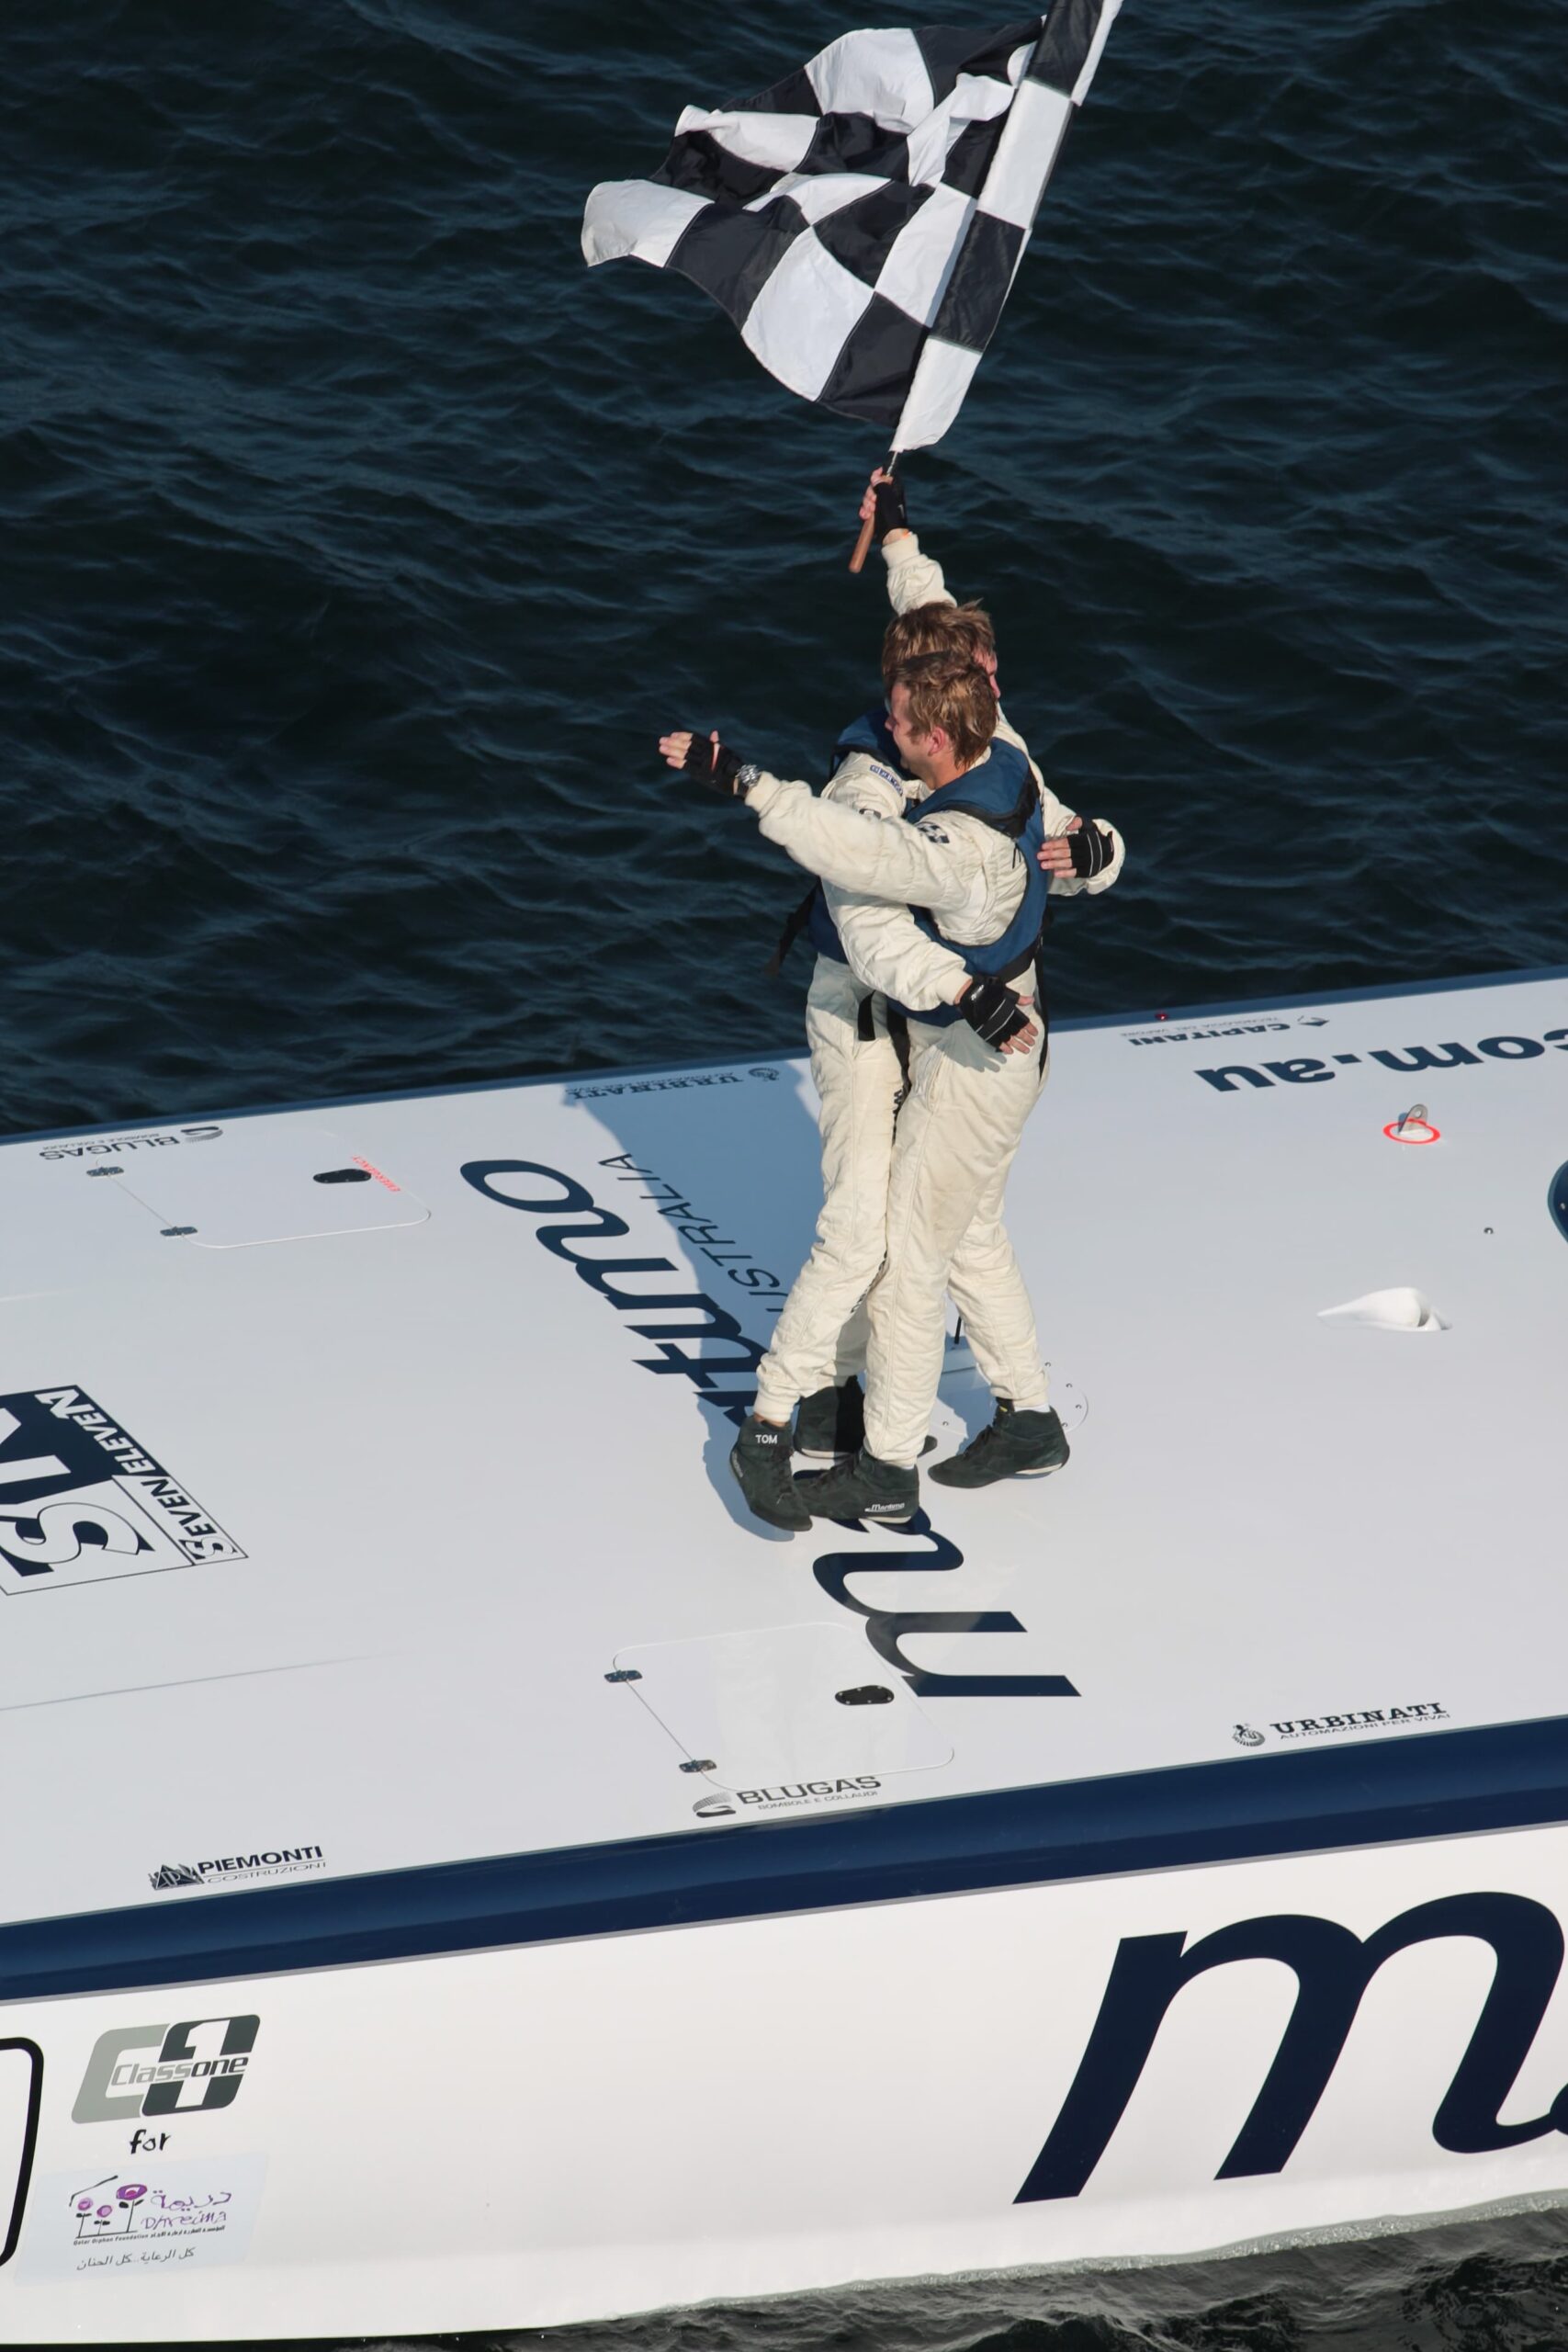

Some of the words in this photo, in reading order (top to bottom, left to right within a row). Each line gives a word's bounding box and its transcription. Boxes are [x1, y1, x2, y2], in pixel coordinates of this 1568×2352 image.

[1128, 1023, 1291, 1046] CAPITANI
[567, 1075, 744, 1099] URBINATI
[39, 1136, 180, 1161] BLUGAS
[34, 1386, 156, 1475] ELEVEN
[755, 1433, 778, 1444] TOM
[141, 1476, 238, 1560] SEVEN
[1269, 1702, 1448, 1734] URBINATI
[1280, 1723, 1379, 1739] AUTOMAZIONI
[1382, 1718, 1411, 1727] PER
[1415, 1713, 1450, 1723] VIVAI
[736, 1775, 882, 1804] BLUGAS
[757, 1798, 810, 1810] BOMBOLE
[824, 1791, 878, 1803] COLLAUDI
[197, 1845, 323, 1874] PIEMONTI
[207, 1861, 326, 1883] COSTRUZIONI
[129, 2129, 171, 2154] for
[92, 2236, 114, 2245] Orphan
[115, 2233, 149, 2242] Foundation
